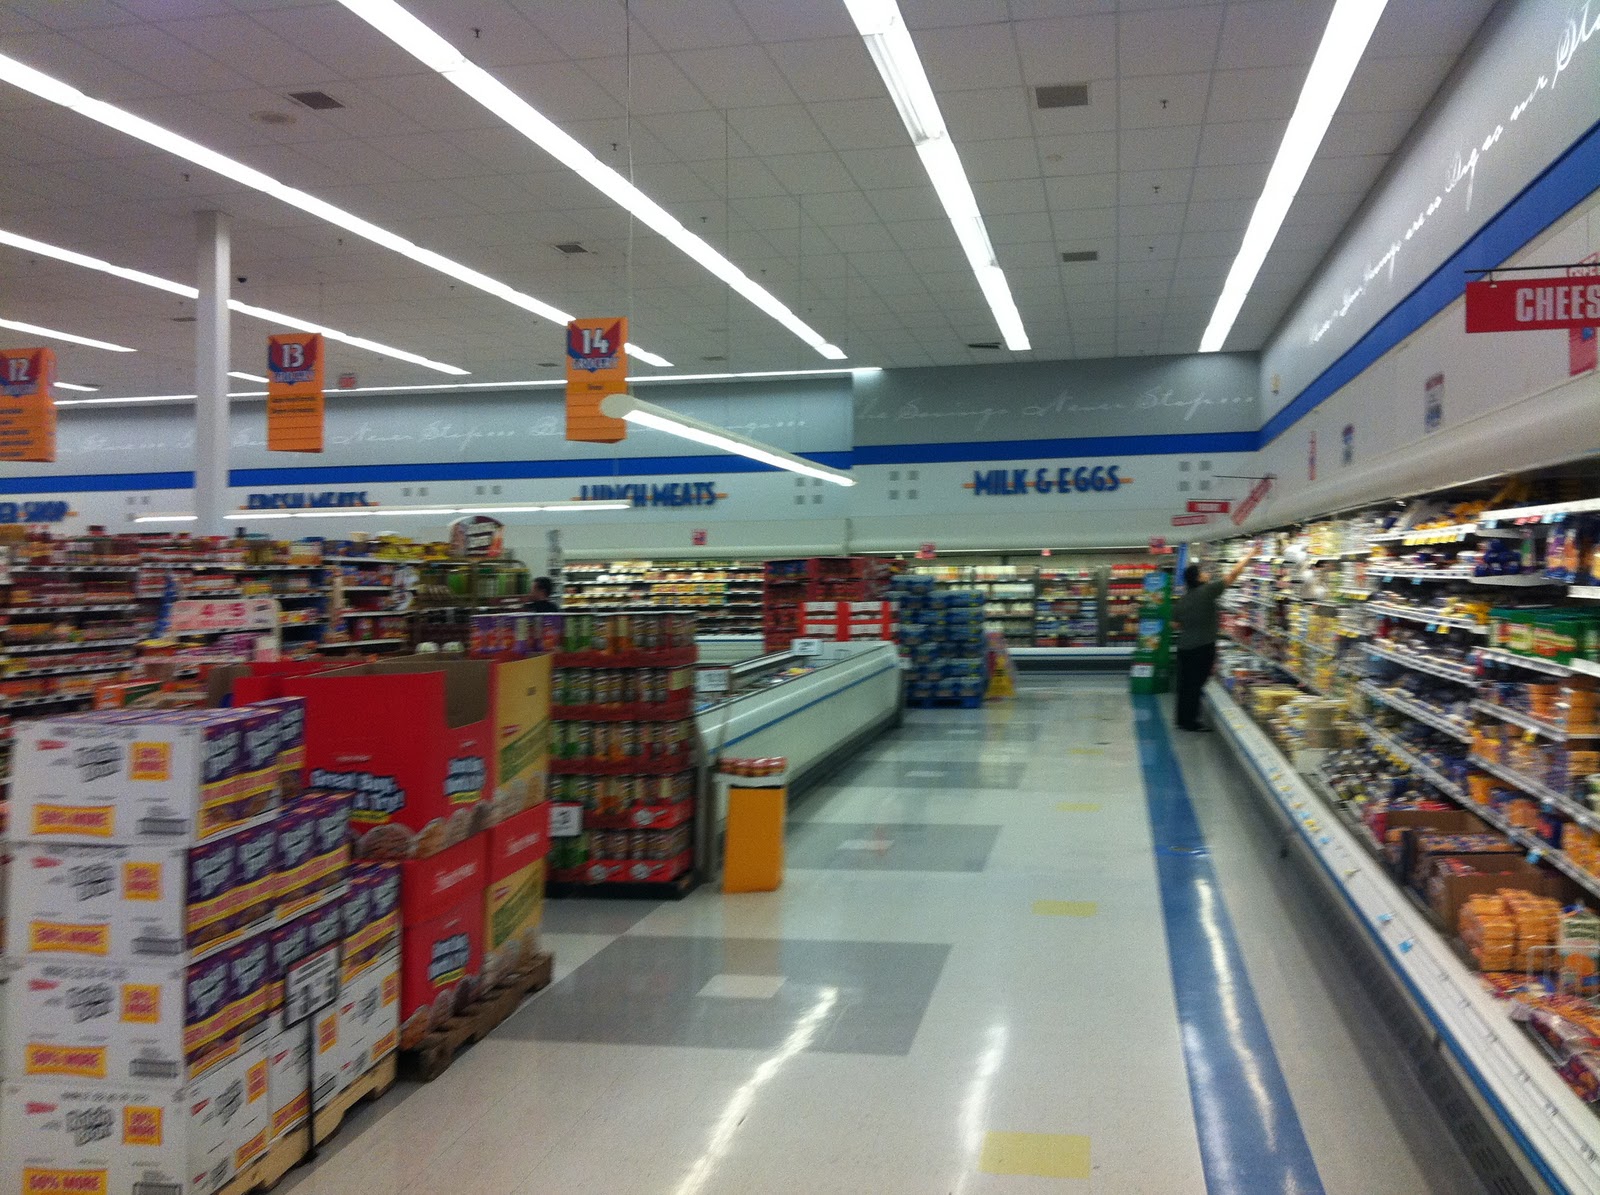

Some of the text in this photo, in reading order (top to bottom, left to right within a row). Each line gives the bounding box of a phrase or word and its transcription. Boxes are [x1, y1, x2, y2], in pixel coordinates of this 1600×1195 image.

[1516, 284, 1600, 322] CHEES
[582, 328, 610, 354] 14
[281, 343, 304, 368] 13
[9, 358, 30, 381] 12
[973, 465, 1120, 495] MILK & EGGS
[651, 482, 715, 506] MEATS
